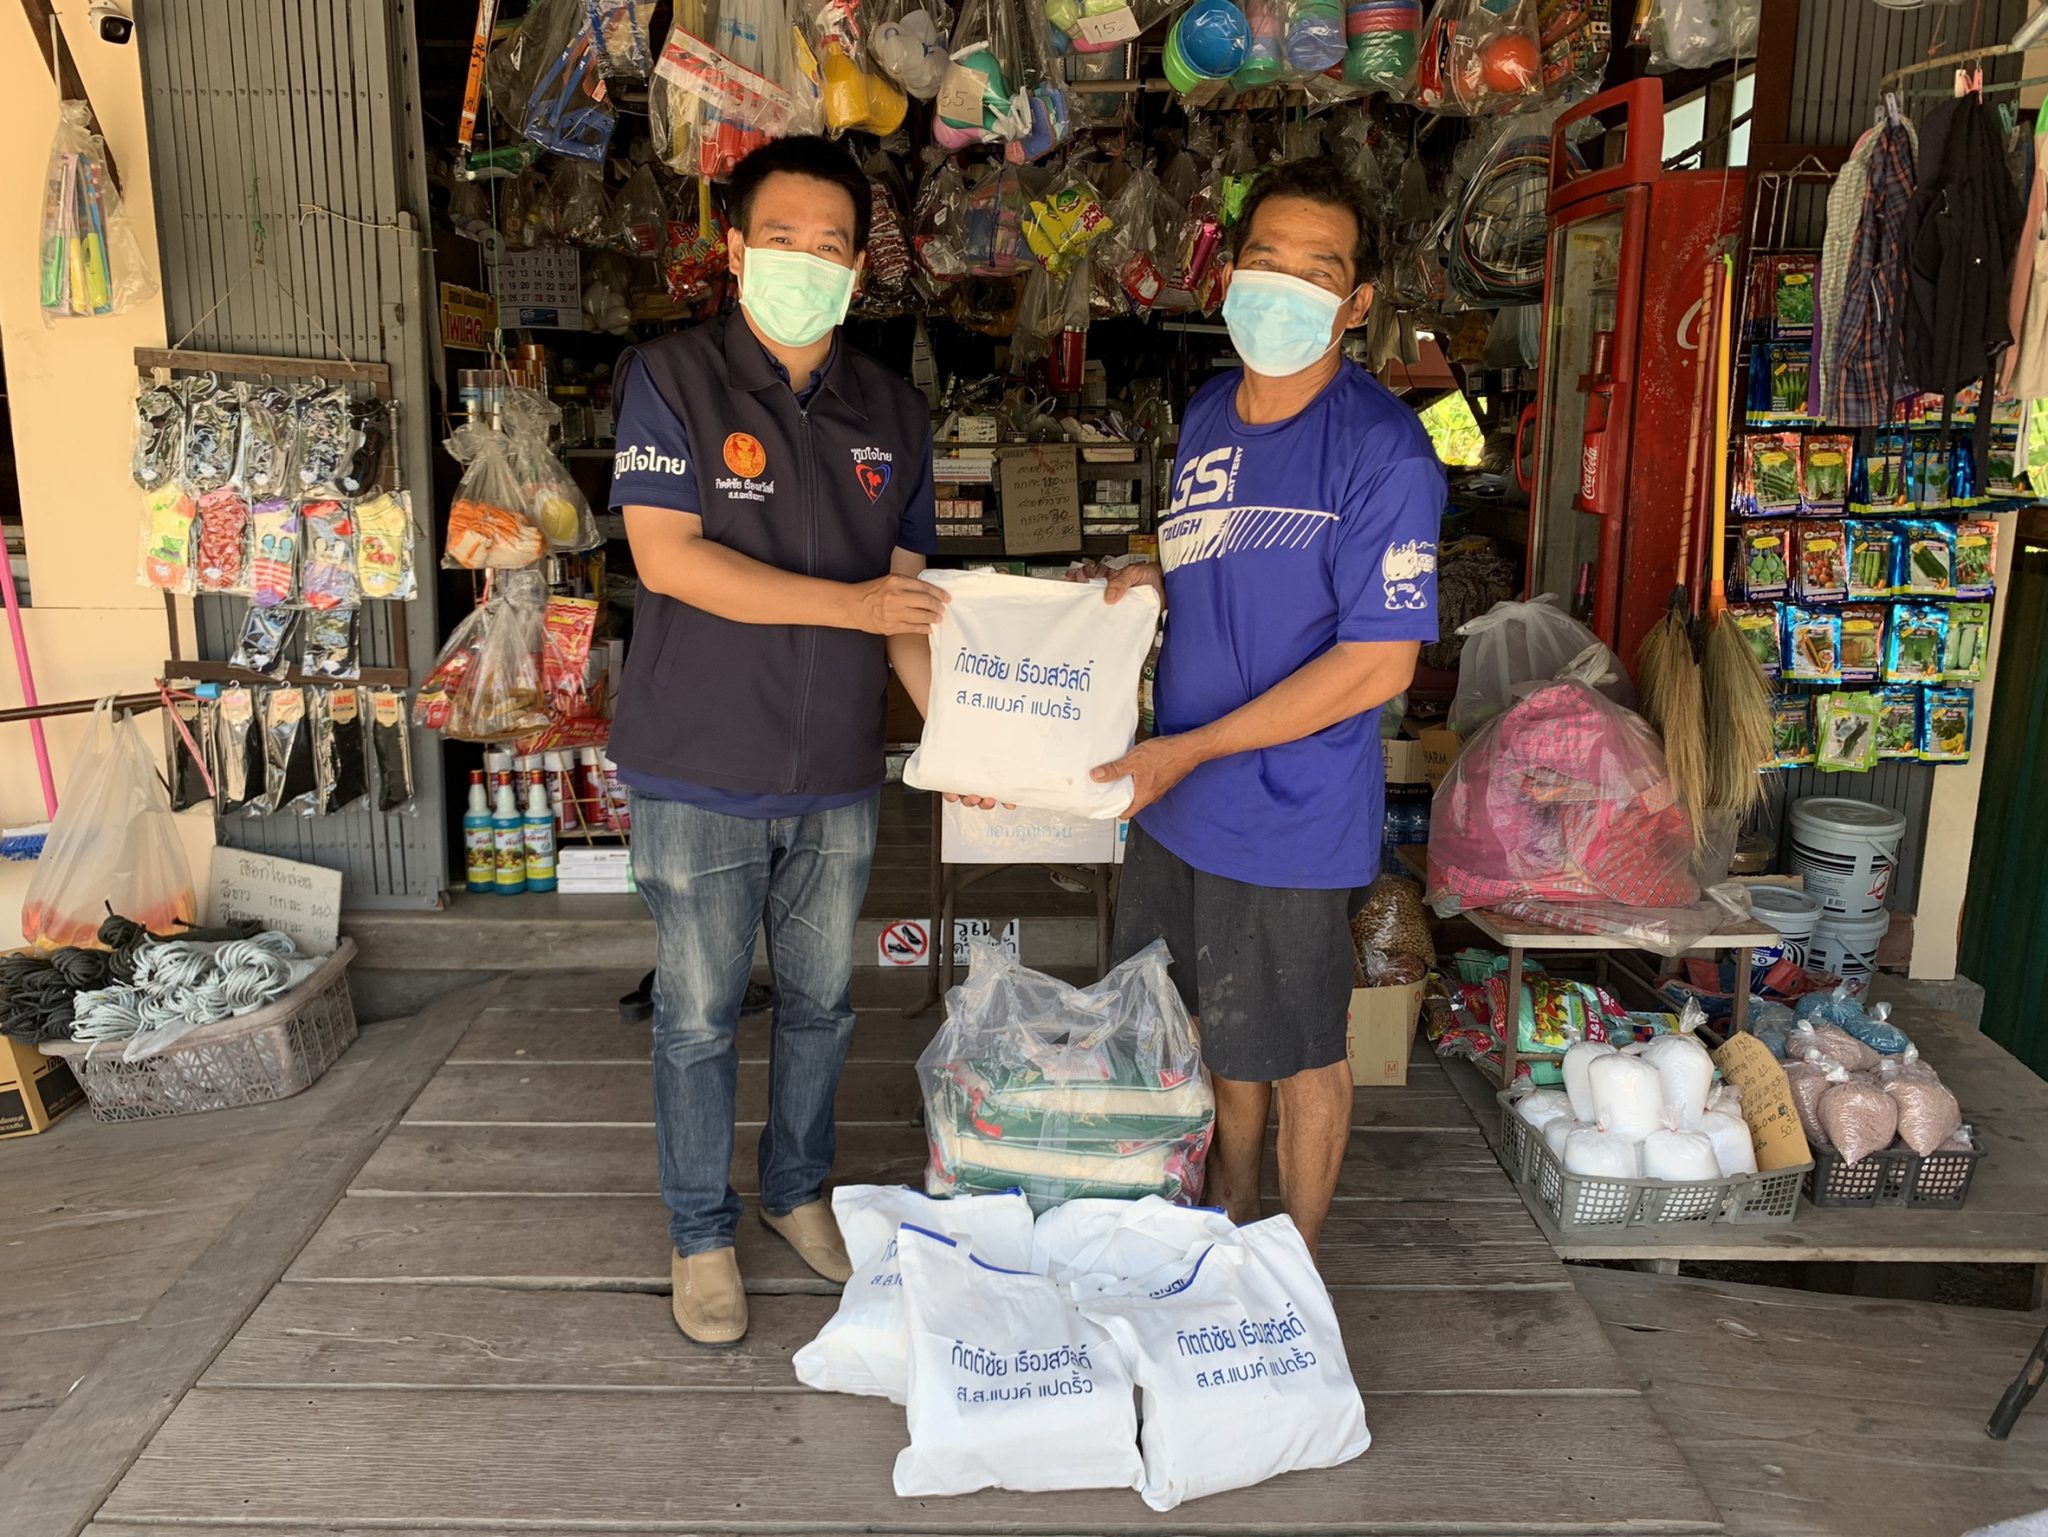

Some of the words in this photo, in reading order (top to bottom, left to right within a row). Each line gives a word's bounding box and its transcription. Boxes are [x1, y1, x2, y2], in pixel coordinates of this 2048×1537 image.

[614, 445, 686, 480] ภูมิใจไทย
[1227, 445, 1243, 502] BATTERY
[1581, 444, 1598, 500] Coca-Cola
[954, 647, 1011, 681] กิตติชัย
[1015, 657, 1095, 693] เรืองสวัสดิ์
[956, 690, 1027, 714] ส.ส.แบงค์
[1030, 695, 1082, 721] แปดริ้ว
[951, 1340, 1008, 1377] กิตติชัย
[1176, 1324, 1237, 1357] กิตติชัย
[956, 1382, 1032, 1403] ส.ส.แบงค์
[1038, 1370, 1094, 1398] แปดริ้ว
[1196, 1355, 1268, 1389] ส.ส.แบงค์
[1269, 1347, 1317, 1377] แปดริ้ว
